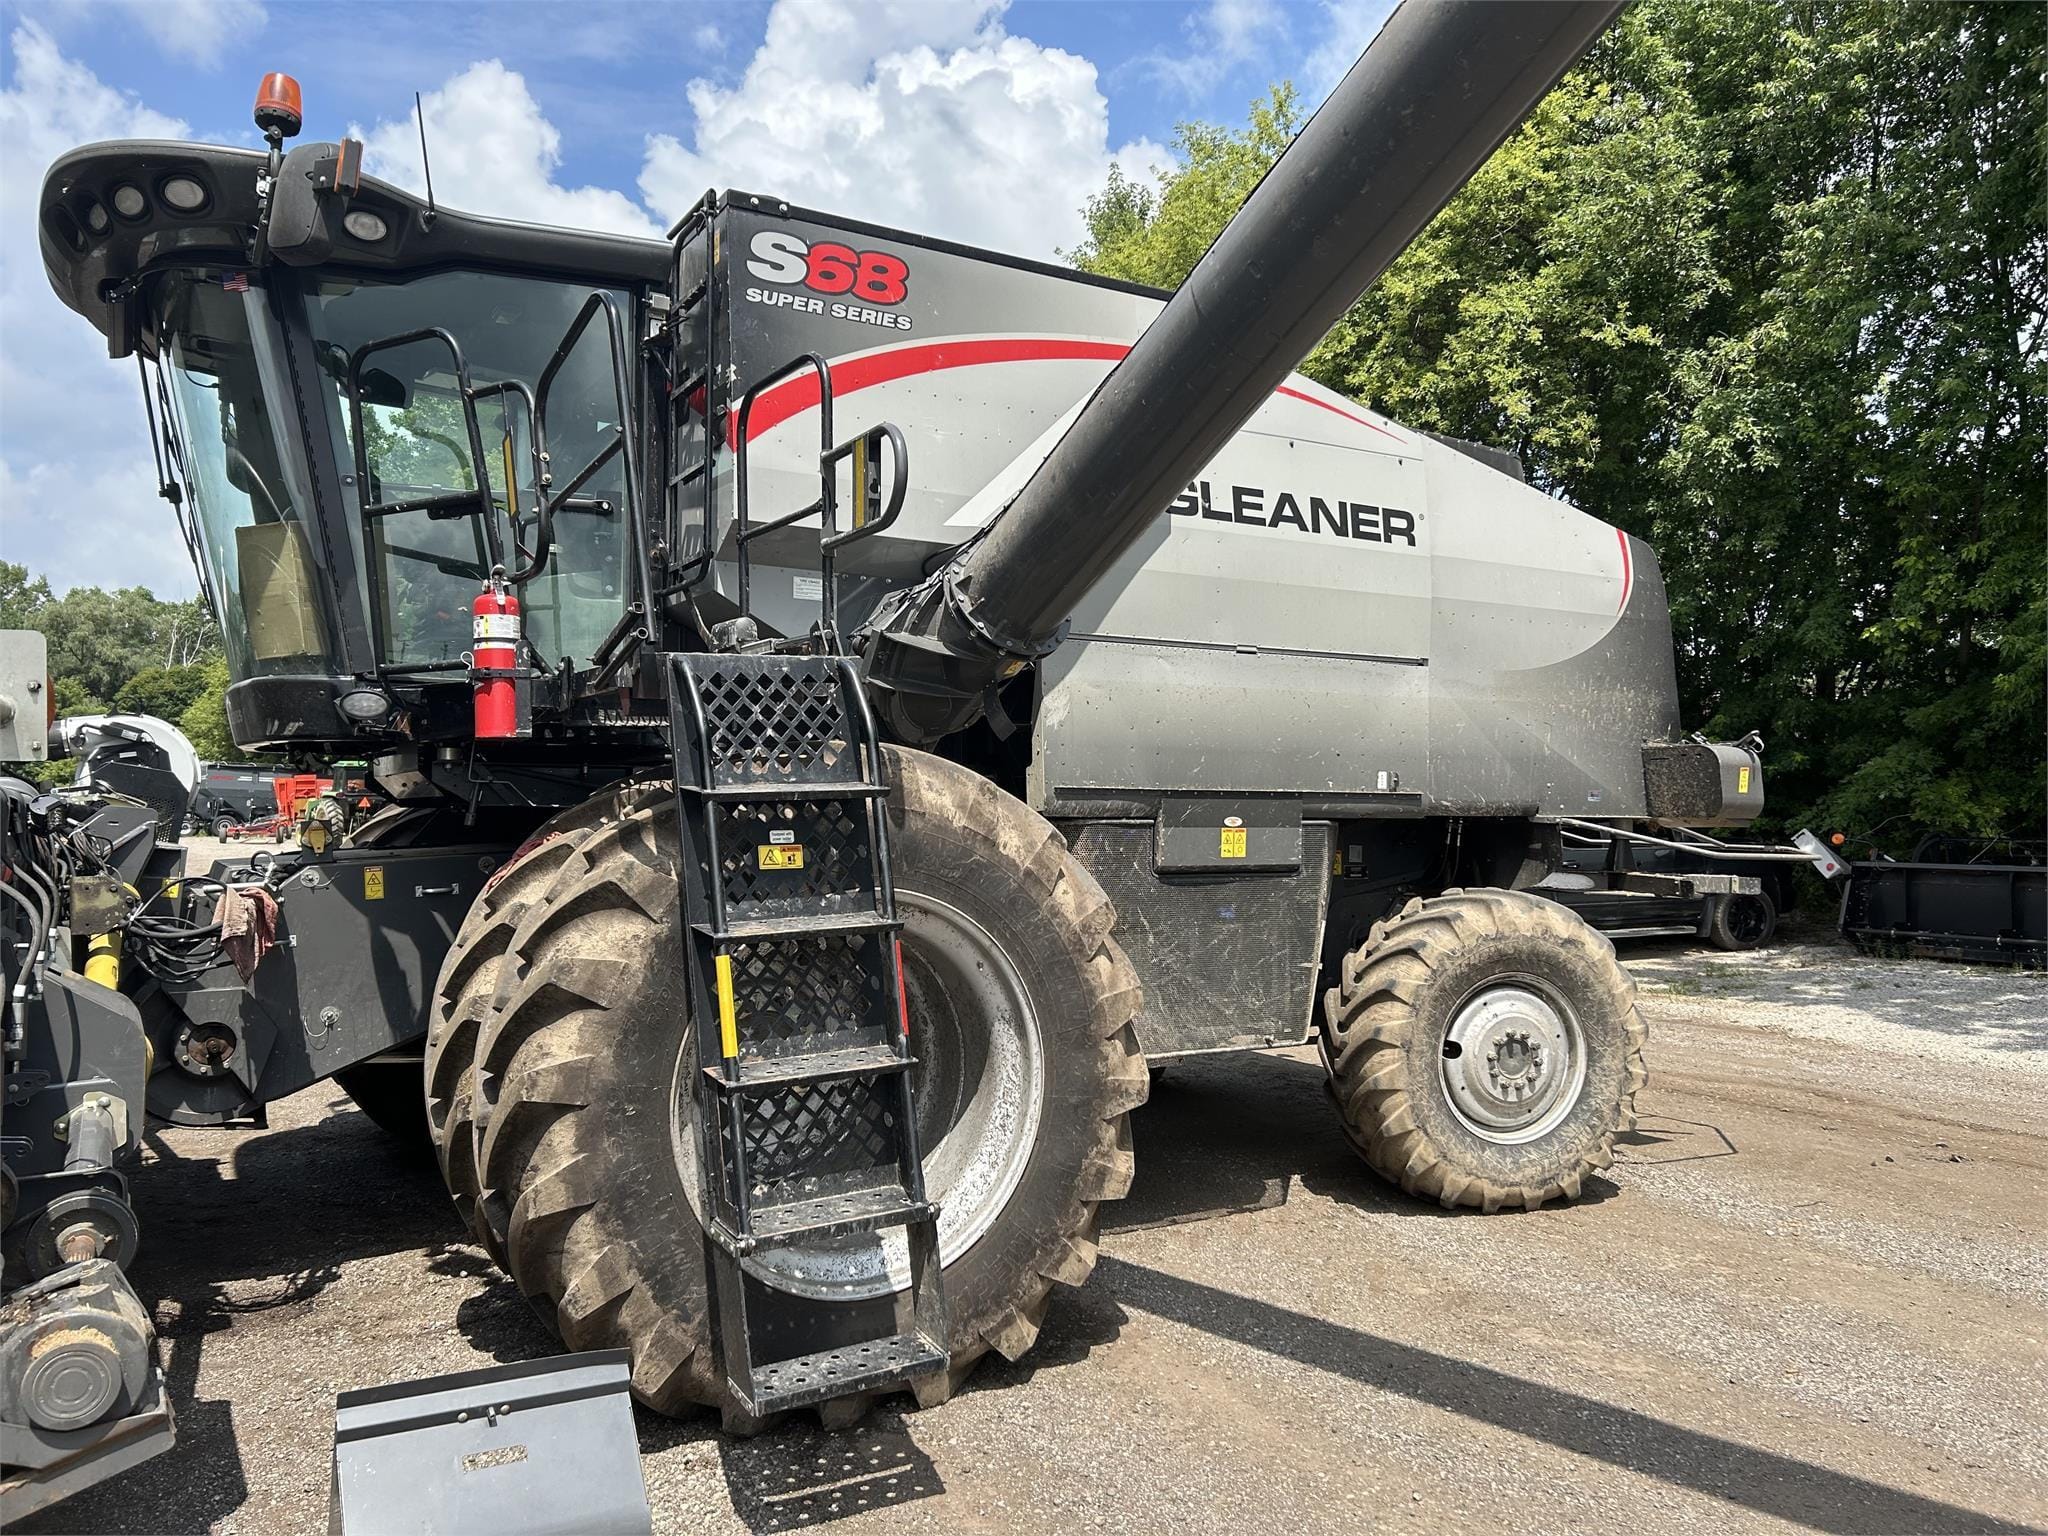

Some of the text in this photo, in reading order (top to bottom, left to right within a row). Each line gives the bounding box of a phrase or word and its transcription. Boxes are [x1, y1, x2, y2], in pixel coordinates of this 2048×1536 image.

[746, 231, 910, 305] S68
[745, 287, 914, 331] SUPER SERIES
